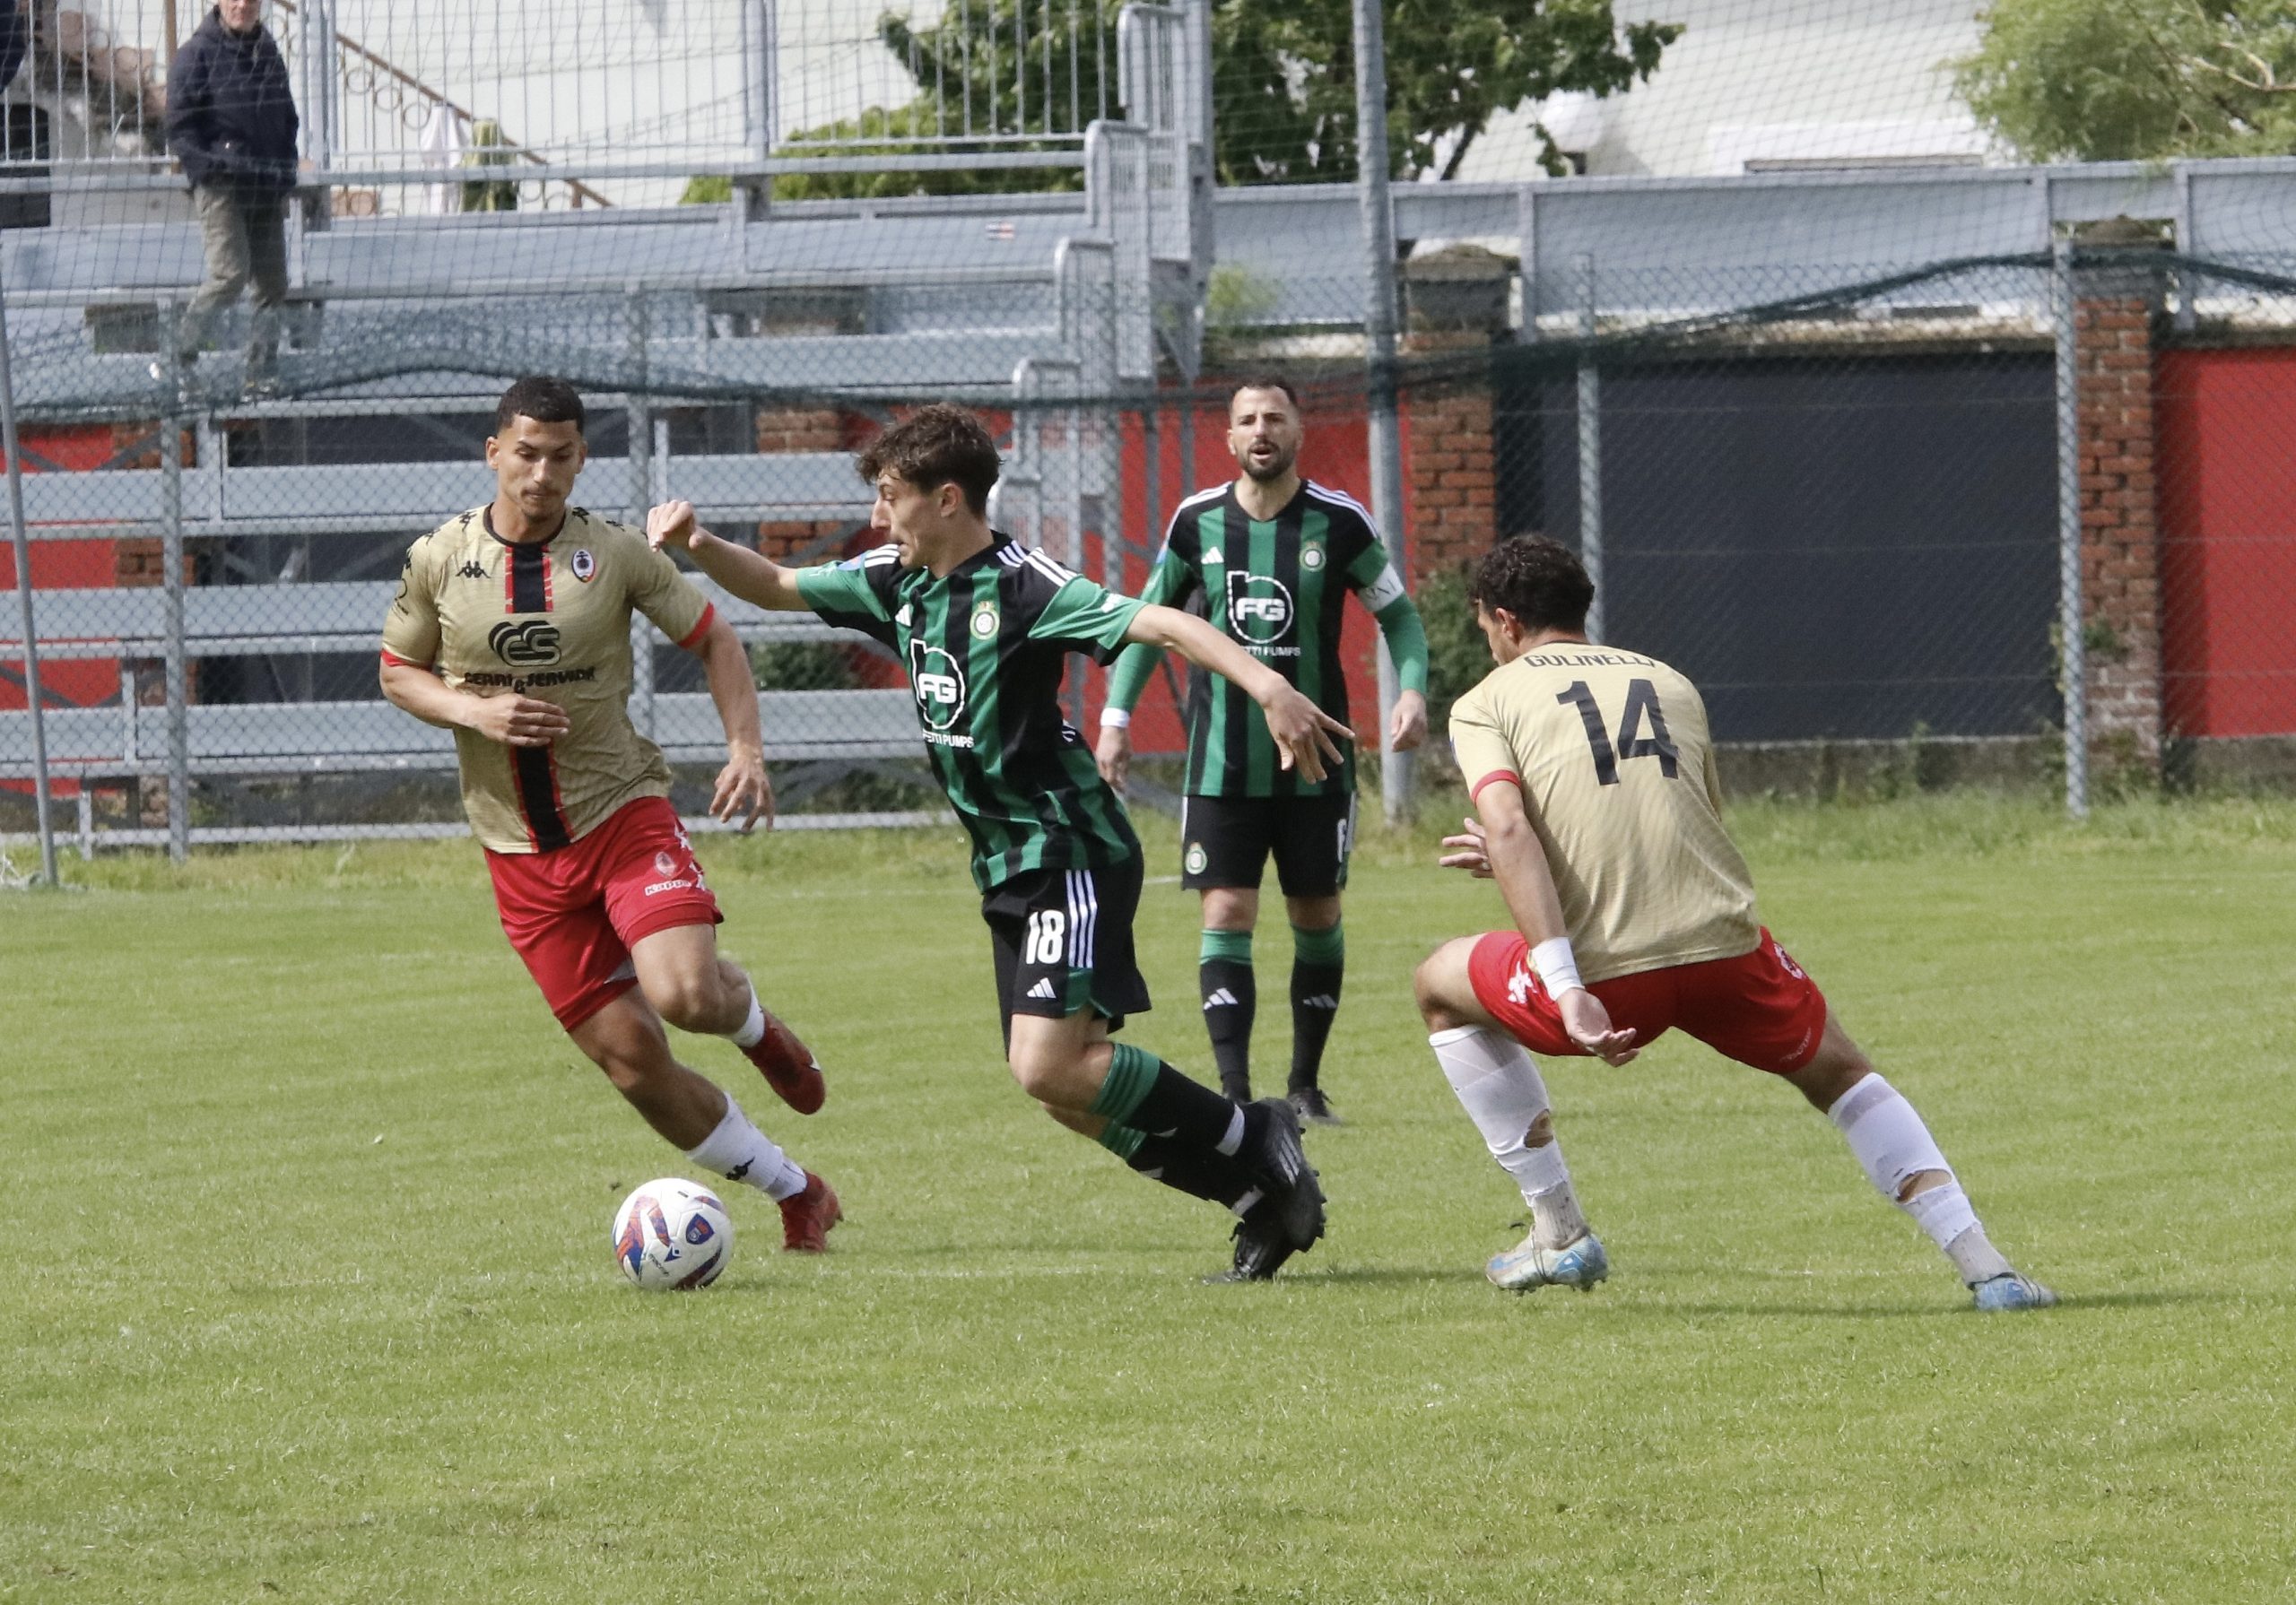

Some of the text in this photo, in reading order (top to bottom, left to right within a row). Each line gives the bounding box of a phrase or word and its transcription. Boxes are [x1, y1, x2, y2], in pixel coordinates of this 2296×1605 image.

[1236, 597, 1285, 621] FG
[1263, 646, 1300, 657] PUMPS
[1524, 653, 1657, 668] GULINELLI
[918, 672, 957, 704] FG
[943, 733, 974, 748] PUMPS
[1555, 678, 1678, 785] 14
[646, 880, 691, 895] Kappa
[1026, 909, 1065, 965] 18
